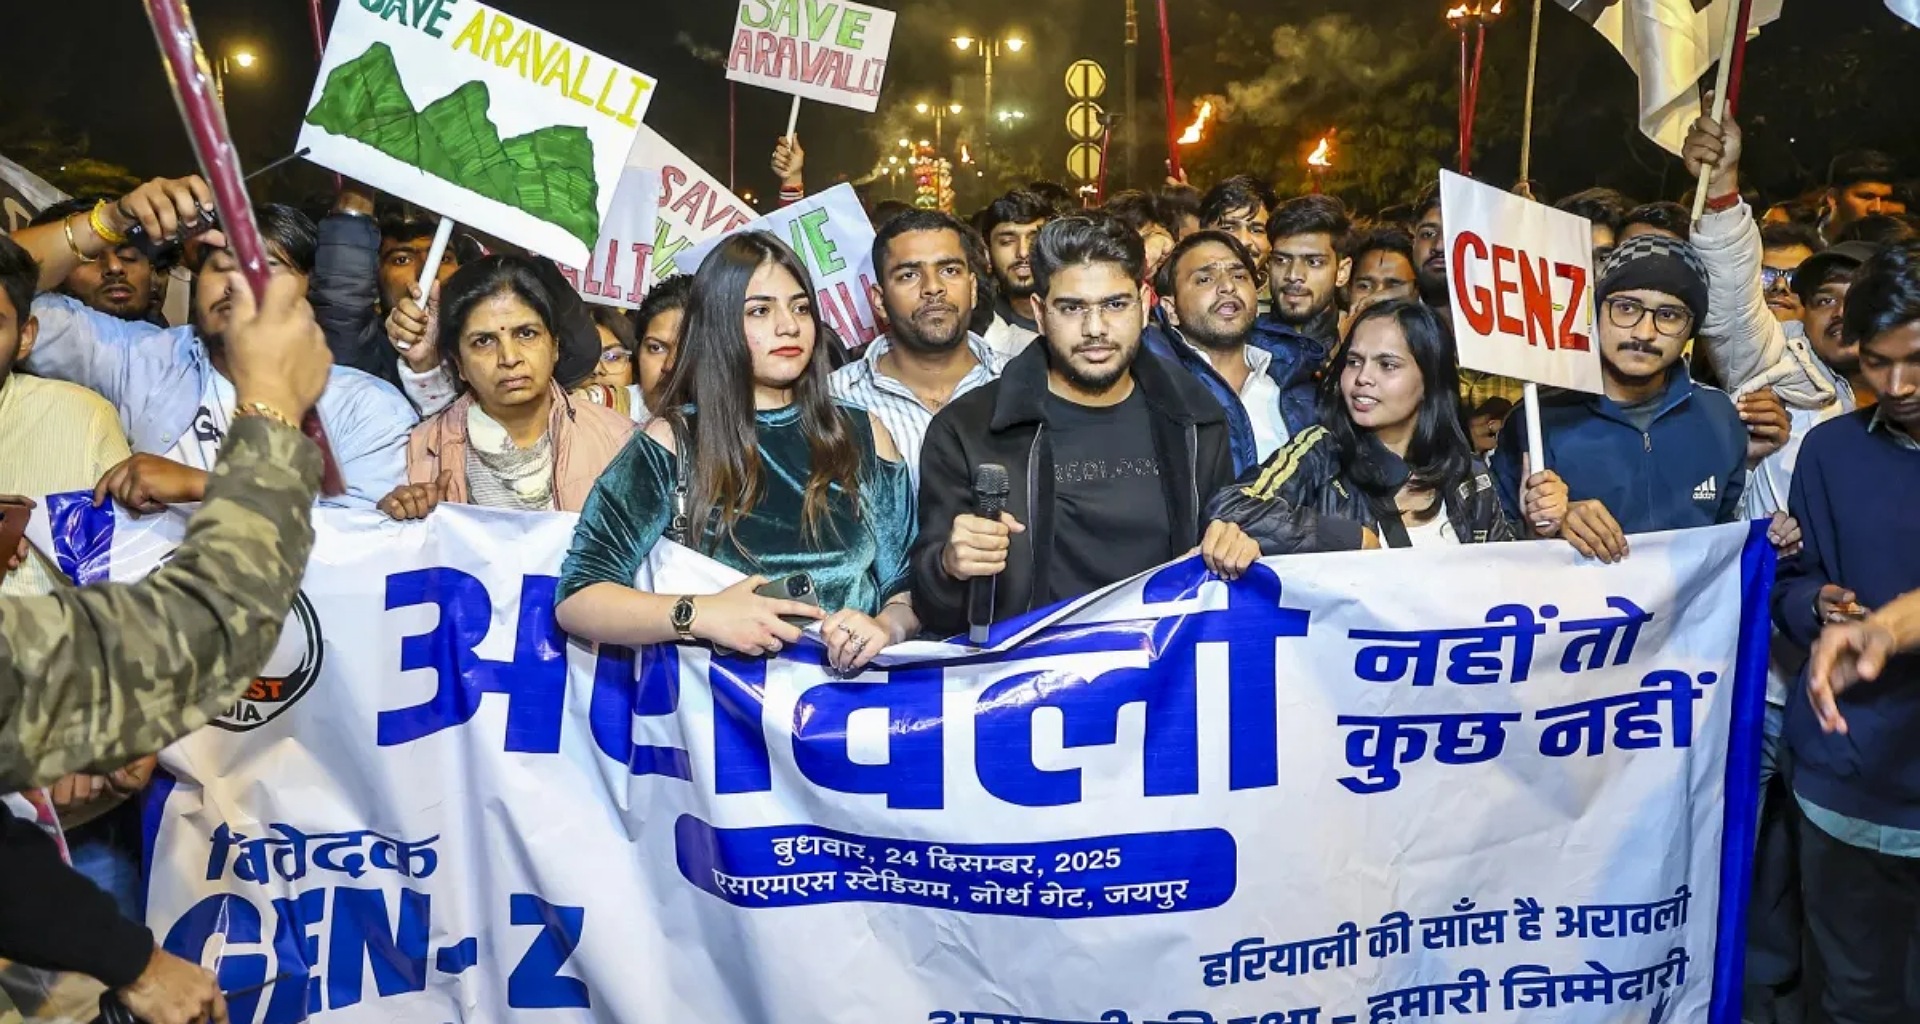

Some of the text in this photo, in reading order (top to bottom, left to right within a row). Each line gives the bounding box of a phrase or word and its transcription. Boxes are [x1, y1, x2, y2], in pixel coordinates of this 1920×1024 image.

[729, 29, 886, 96] ARAVALLI
[741, 0, 872, 49] SAVE
[452, 8, 651, 127] ARAVALLI
[1348, 596, 1654, 687] नहीं तो
[1337, 669, 1718, 794] कुछ नहीं
[712, 870, 838, 900] एसएमएस
[844, 865, 960, 904] स्टेडियम,
[1039, 881, 1094, 910] गेट,
[1104, 879, 1190, 909] जयपुर
[771, 835, 1122, 878] बुधवार, 24 दिसम्बर, 2025
[1199, 884, 1692, 988] हरियाली की साँस है अरावली
[1367, 968, 1490, 1024] हमारी
[1499, 946, 1690, 1010] जिम्मेदारी
